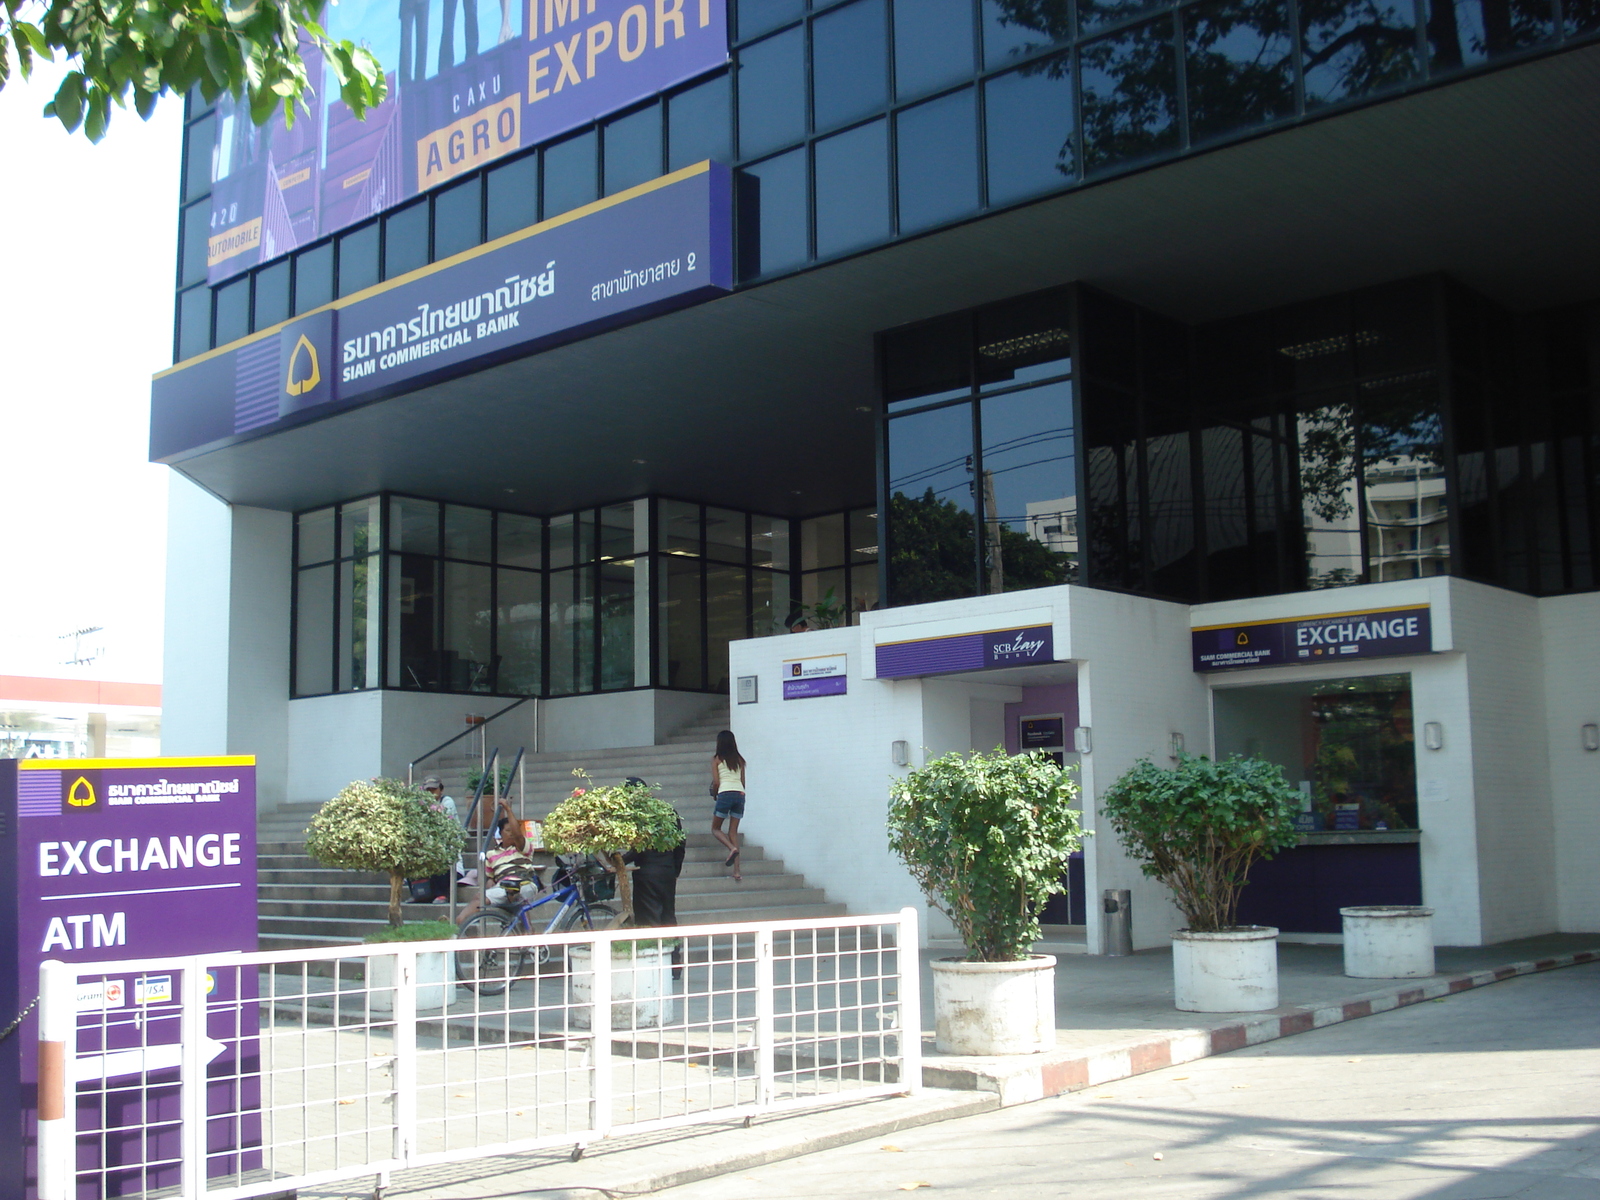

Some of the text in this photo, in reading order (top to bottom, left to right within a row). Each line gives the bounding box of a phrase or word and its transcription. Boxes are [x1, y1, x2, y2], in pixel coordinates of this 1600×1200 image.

[453, 74, 501, 114] CAXU
[426, 106, 515, 177] AGRO
[591, 251, 696, 302] สาขาพัทยาสาย 2
[343, 260, 556, 364] ธนาคารไทยพาณิชย์
[342, 311, 520, 383] SIAM COMMERCIAL BANK
[993, 643, 1011, 653] SCB
[1296, 617, 1419, 646] EXCHANGE
[1200, 649, 1271, 662] SIAM COMMERCIAL BANK
[39, 832, 242, 877] EXCHANGE
[41, 911, 126, 952] ATM
